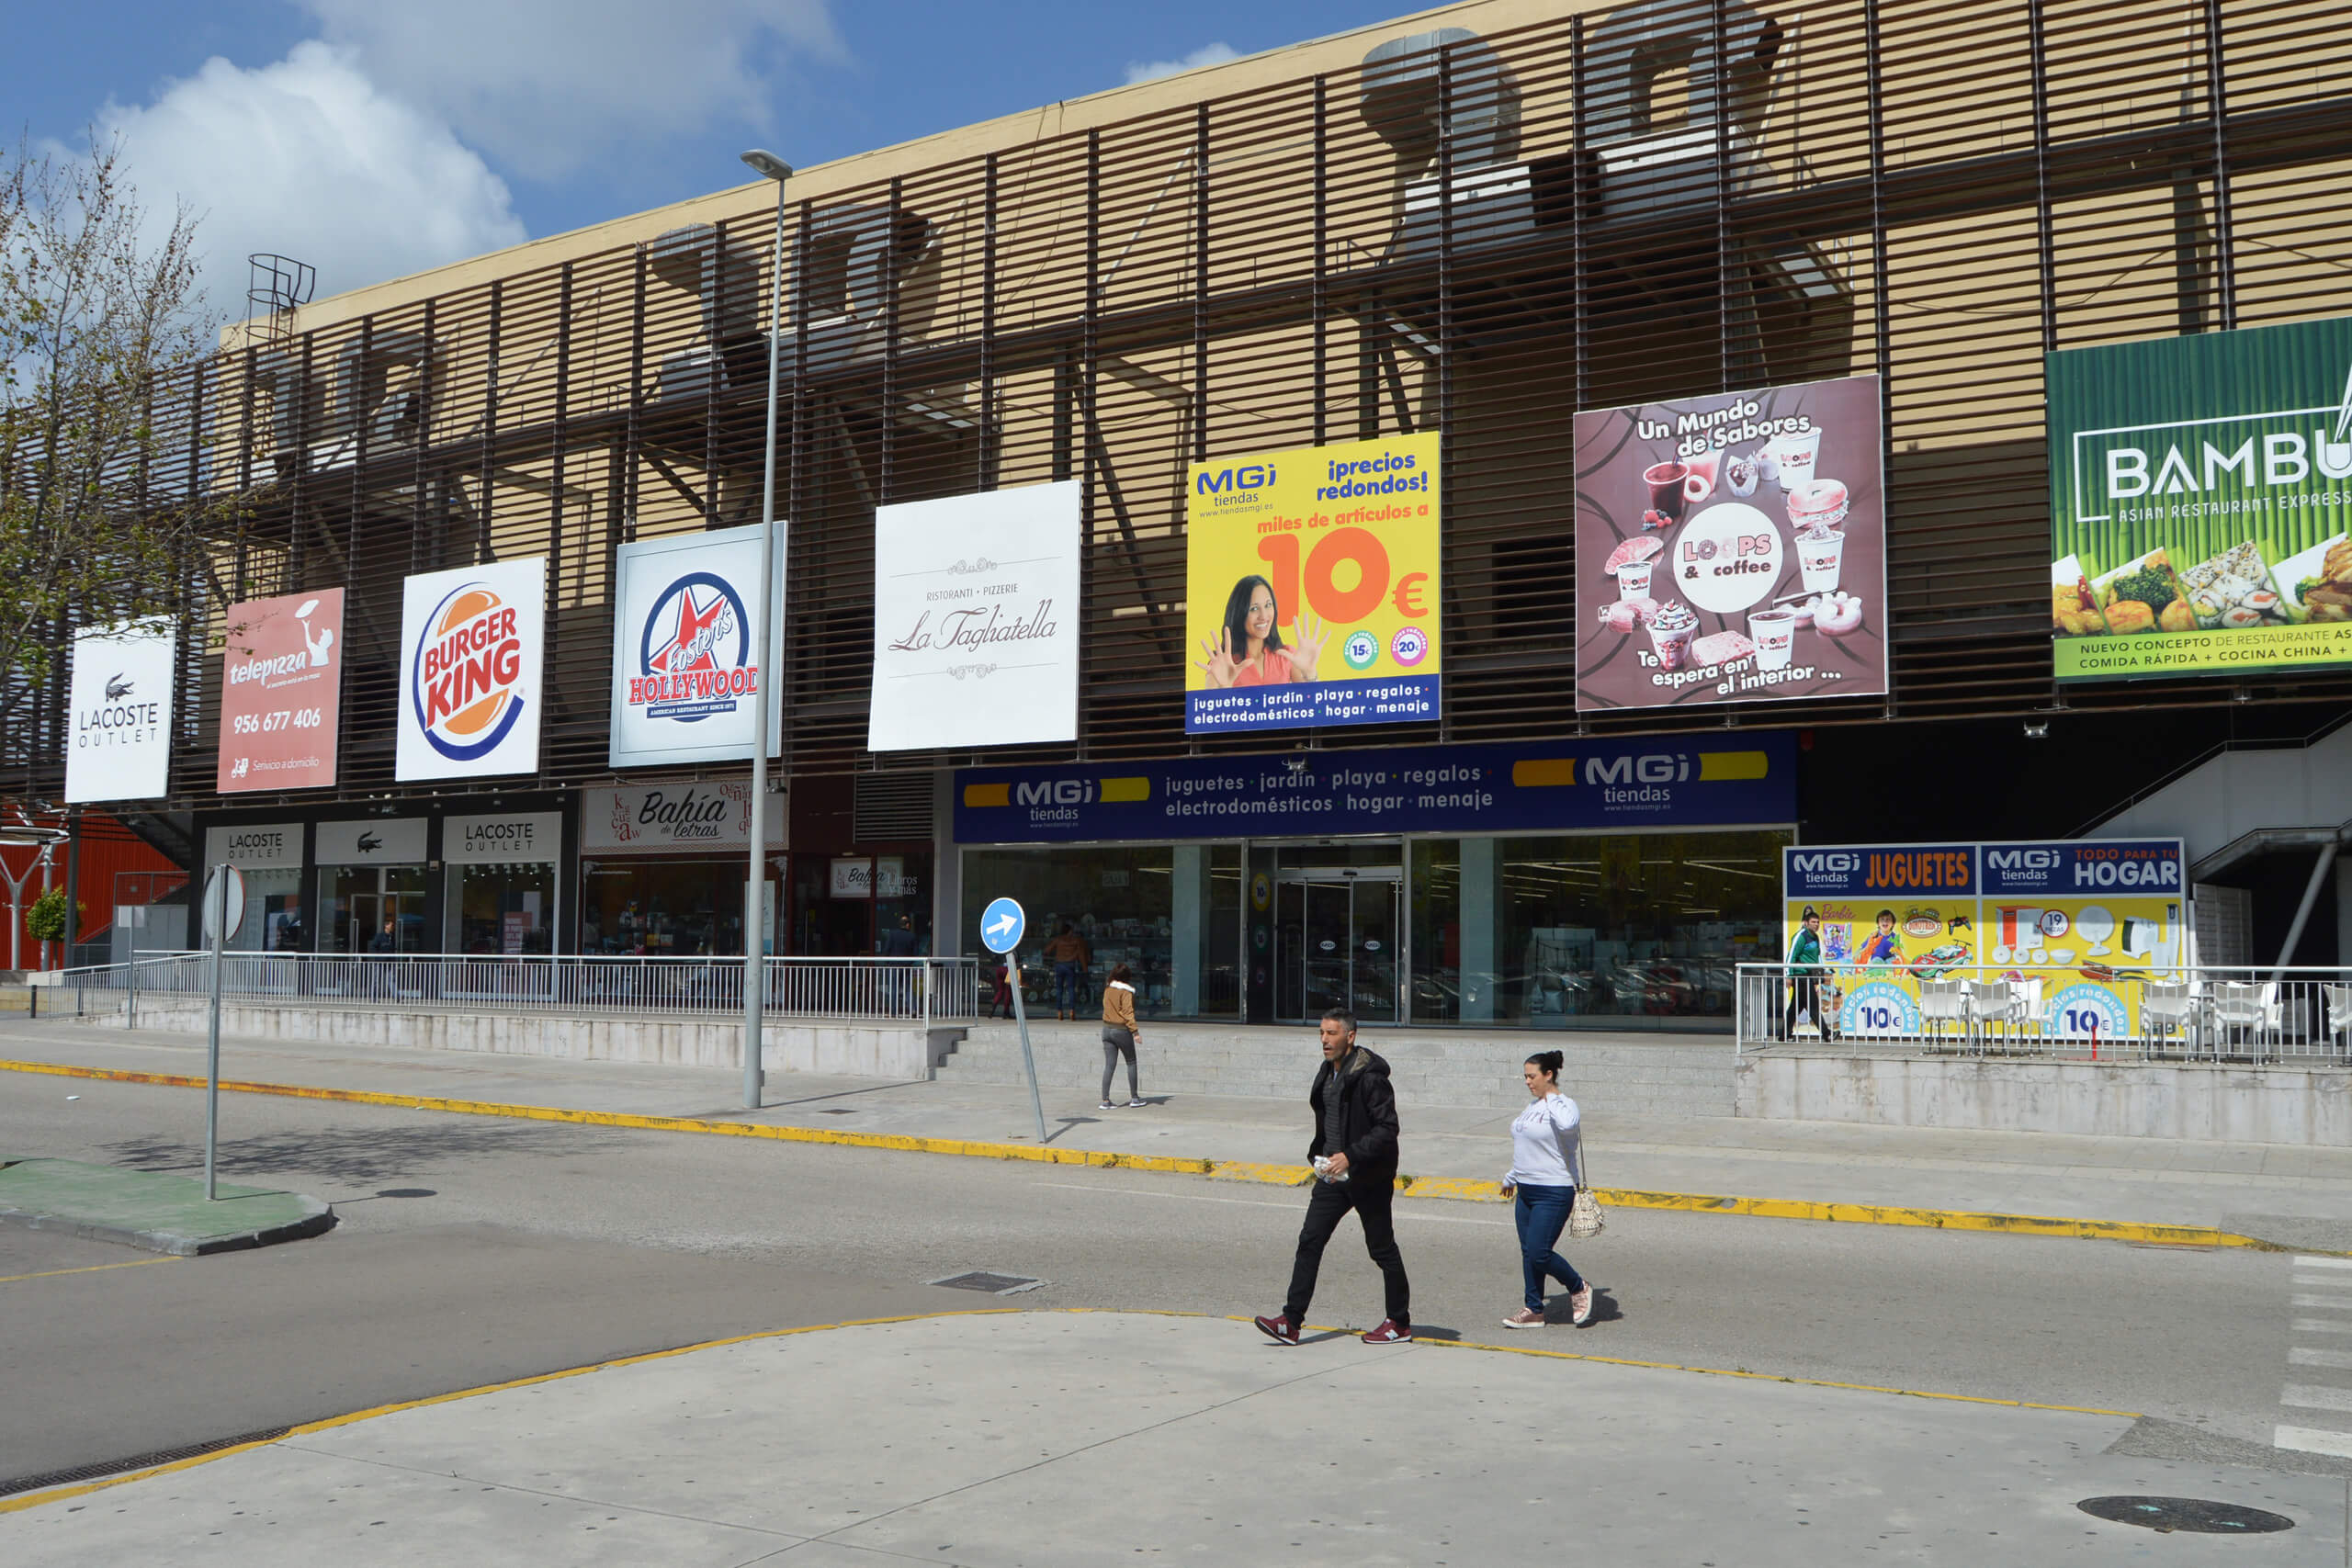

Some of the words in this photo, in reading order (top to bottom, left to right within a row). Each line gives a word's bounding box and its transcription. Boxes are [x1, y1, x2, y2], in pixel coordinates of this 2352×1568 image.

[1638, 420, 1669, 440] Un
[1677, 398, 1759, 434] Mundo
[1677, 434, 1707, 457] de
[1713, 415, 1811, 449] Sabores
[1329, 451, 1416, 482] ¡precios
[1317, 470, 1429, 502] redondos!
[1199, 502, 1273, 519] www.tiendasmgi.es
[1214, 491, 1259, 507] tiendas
[2119, 507, 2164, 522] ASIAN
[2171, 497, 2271, 518] RESTAURANT
[2279, 491, 2352, 509] EXPRESS
[1257, 515, 1302, 534] miles
[1307, 512, 1329, 529] de
[1335, 503, 1412, 525] artículos
[1418, 503, 1429, 517] a
[1684, 566, 1700, 579] &
[1713, 559, 1771, 576] coffee
[926, 588, 973, 602] RISTORANTI
[983, 583, 1018, 596] PIZZERIE
[888, 610, 932, 651] La
[933, 598, 1057, 652] Tagliatella
[424, 607, 516, 683] BURGER
[669, 607, 733, 671] Foster's
[2081, 642, 2130, 654] NUEVO
[2134, 637, 2211, 651] CONCEPTO
[2216, 636, 2233, 647] DE
[2237, 630, 2330, 645] RESTAURANTE
[230, 651, 306, 686] telepizza
[1637, 650, 1660, 668] Te
[2079, 657, 2138, 669] COMIDA
[2144, 653, 2198, 665] RÁPIDA
[2219, 649, 2278, 661] COCINA
[2284, 646, 2332, 658] CHINA
[426, 638, 520, 729] KING
[1652, 665, 1718, 689] espera
[1724, 658, 1750, 674] en
[1717, 675, 1735, 695] el
[1741, 664, 1815, 690] interior
[1194, 697, 1251, 713] juguetes
[1262, 692, 1304, 708] jardín
[1315, 688, 1354, 705] playa
[1365, 683, 1421, 701] regalos
[80, 703, 158, 730] LACOSTE
[234, 713, 259, 734] 956
[263, 710, 291, 731] 677
[294, 707, 322, 728] 406
[1194, 707, 1315, 725] electrodomésticos
[1326, 704, 1366, 720] hogar
[1376, 699, 1430, 715] menaje
[79, 728, 157, 748] OUTLET
[1166, 774, 1245, 797] juguetes
[1260, 771, 1316, 793] jardín
[1332, 768, 1386, 790] playa
[1404, 764, 1481, 786] regalos
[639, 788, 727, 825] Bahía
[1166, 795, 1332, 817] electrodomésticos
[1346, 793, 1404, 814] hogar
[1419, 789, 1493, 811] menaje
[1604, 785, 1670, 803] tiendas
[1030, 806, 1079, 821] tiendas
[229, 833, 282, 848] LACOSTE
[466, 823, 534, 840] LACOSTE
[661, 825, 672, 835] de
[673, 818, 720, 838] letras
[229, 848, 282, 859] OUTLET
[466, 840, 534, 852] OUTLET
[2075, 849, 2120, 860] TODO
[2124, 850, 2157, 859] PARA
[2163, 850, 2177, 860] TU
[1805, 872, 1849, 883] tiendas
[1865, 852, 1969, 887] JUGUETES
[2001, 869, 2048, 881] tiendas
[2075, 861, 2177, 886] HOGAR
[1821, 903, 1856, 920] Barbie
[2048, 913, 2062, 926] 19
